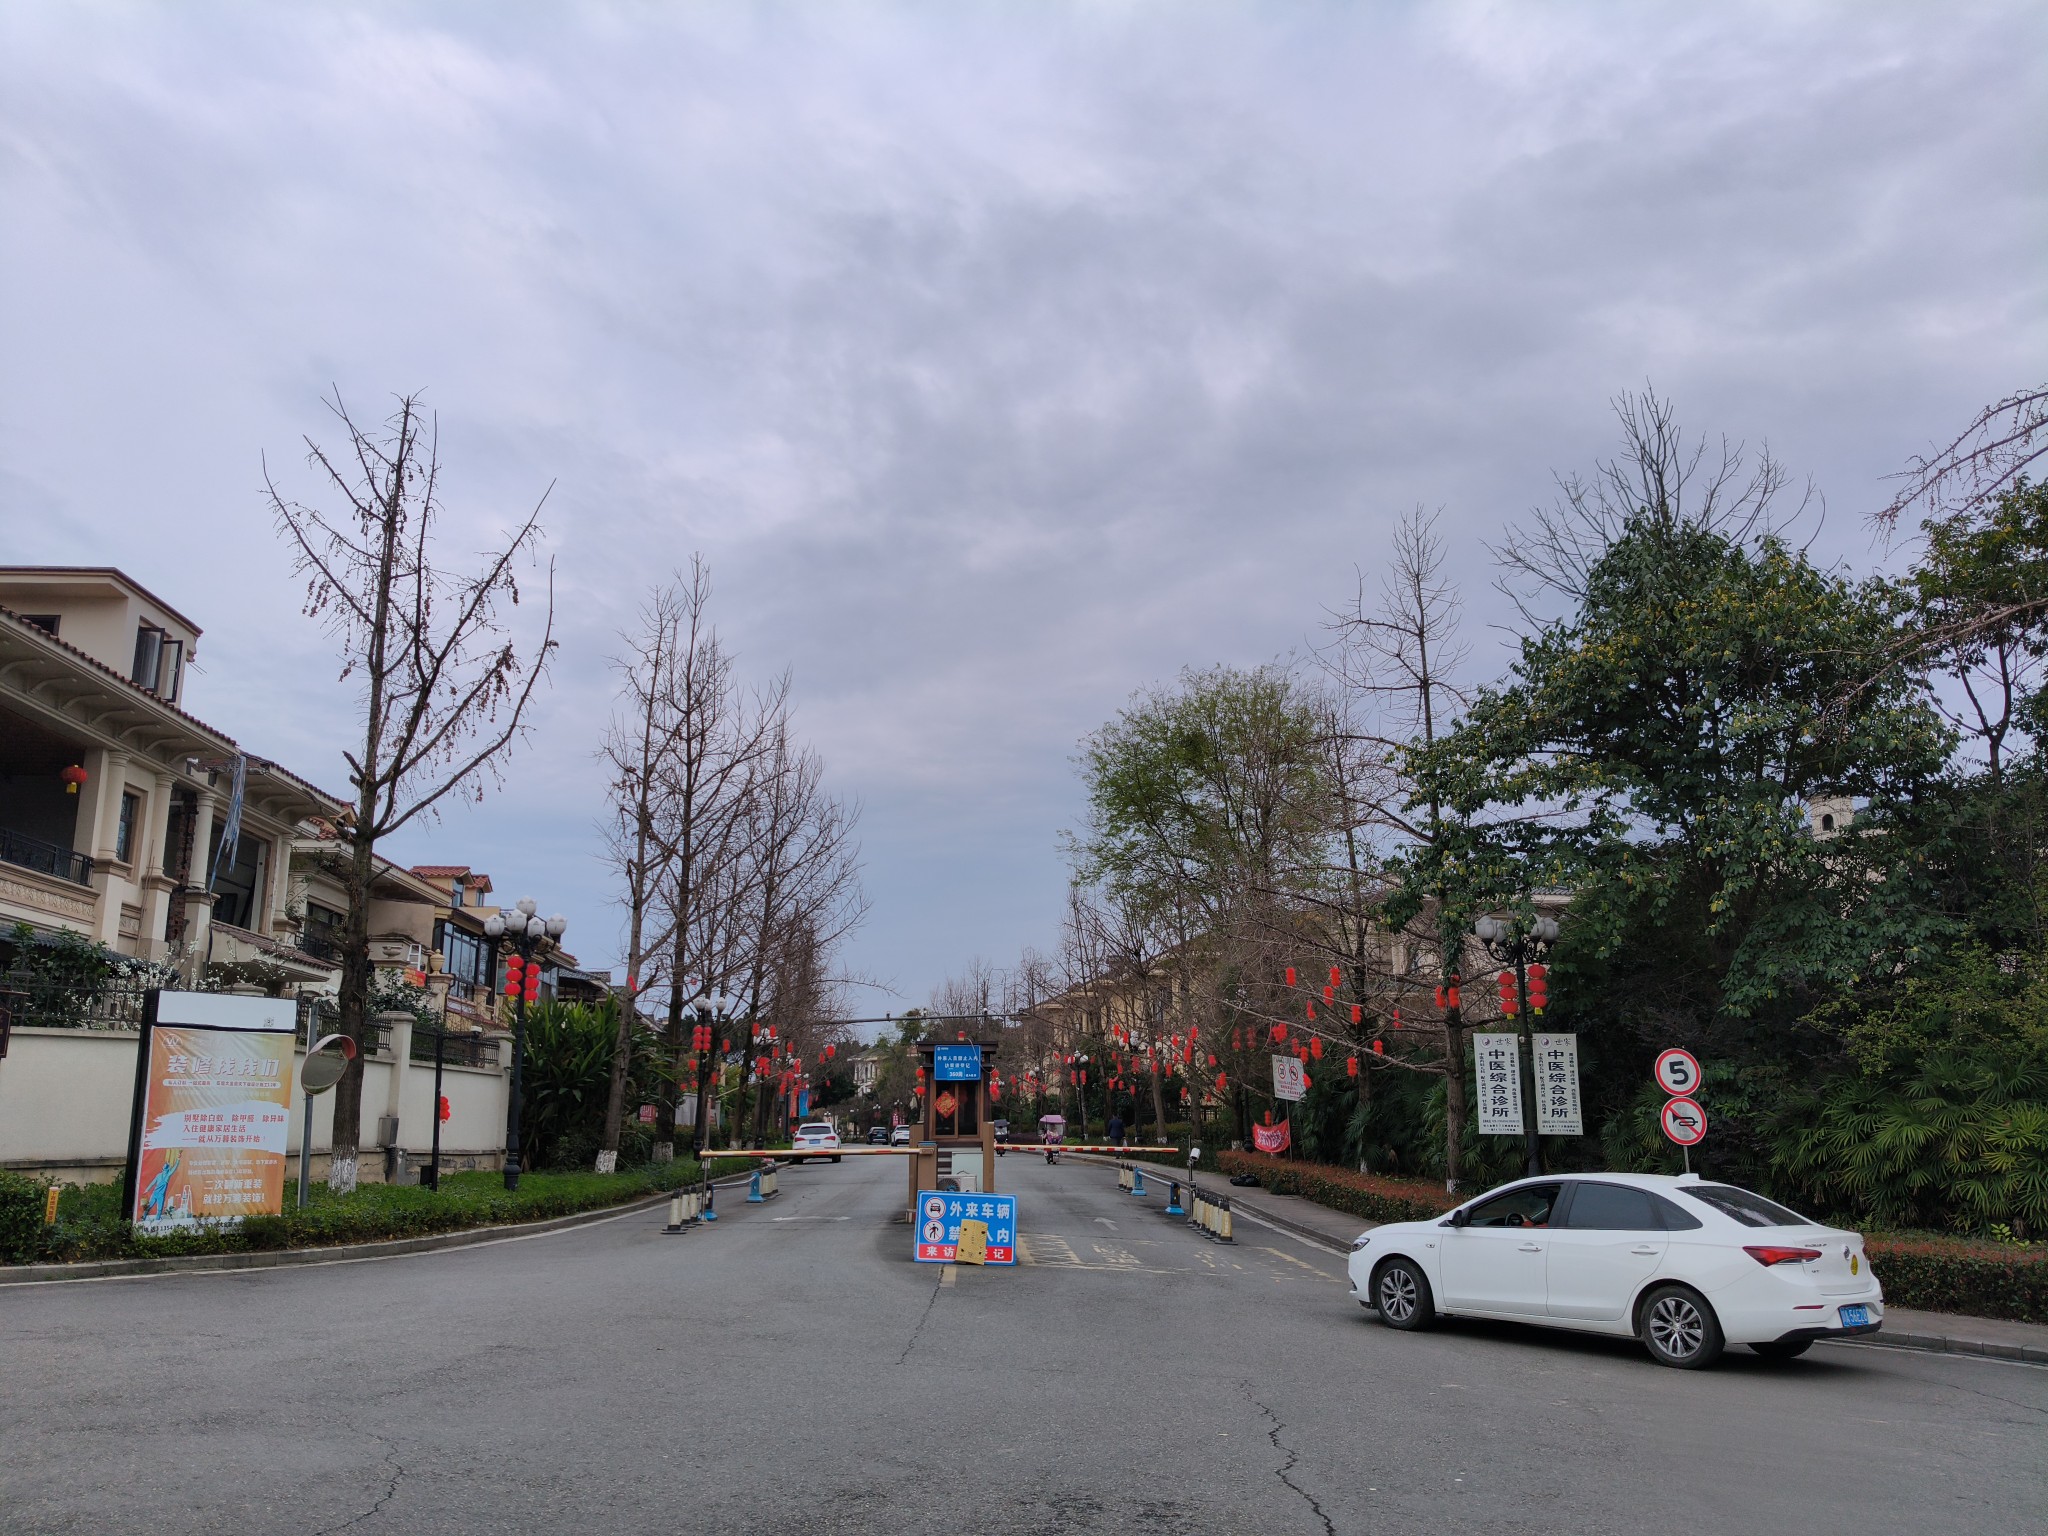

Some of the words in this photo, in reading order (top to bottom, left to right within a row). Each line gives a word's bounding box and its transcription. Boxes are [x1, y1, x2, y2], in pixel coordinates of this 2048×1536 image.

[167, 1054, 281, 1078] 装修找我们
[1669, 1061, 1689, 1085] 5
[1488, 1049, 1510, 1118] 中医综合诊所
[1547, 1049, 1569, 1118] 中医综合诊所
[183, 1124, 247, 1133] 入住健康家居生活
[184, 1113, 224, 1123] 别墅除白蚁
[231, 1113, 255, 1123] 除甲醛
[262, 1114, 284, 1123] 除异味
[950, 1201, 1010, 1219] 外来车辆
